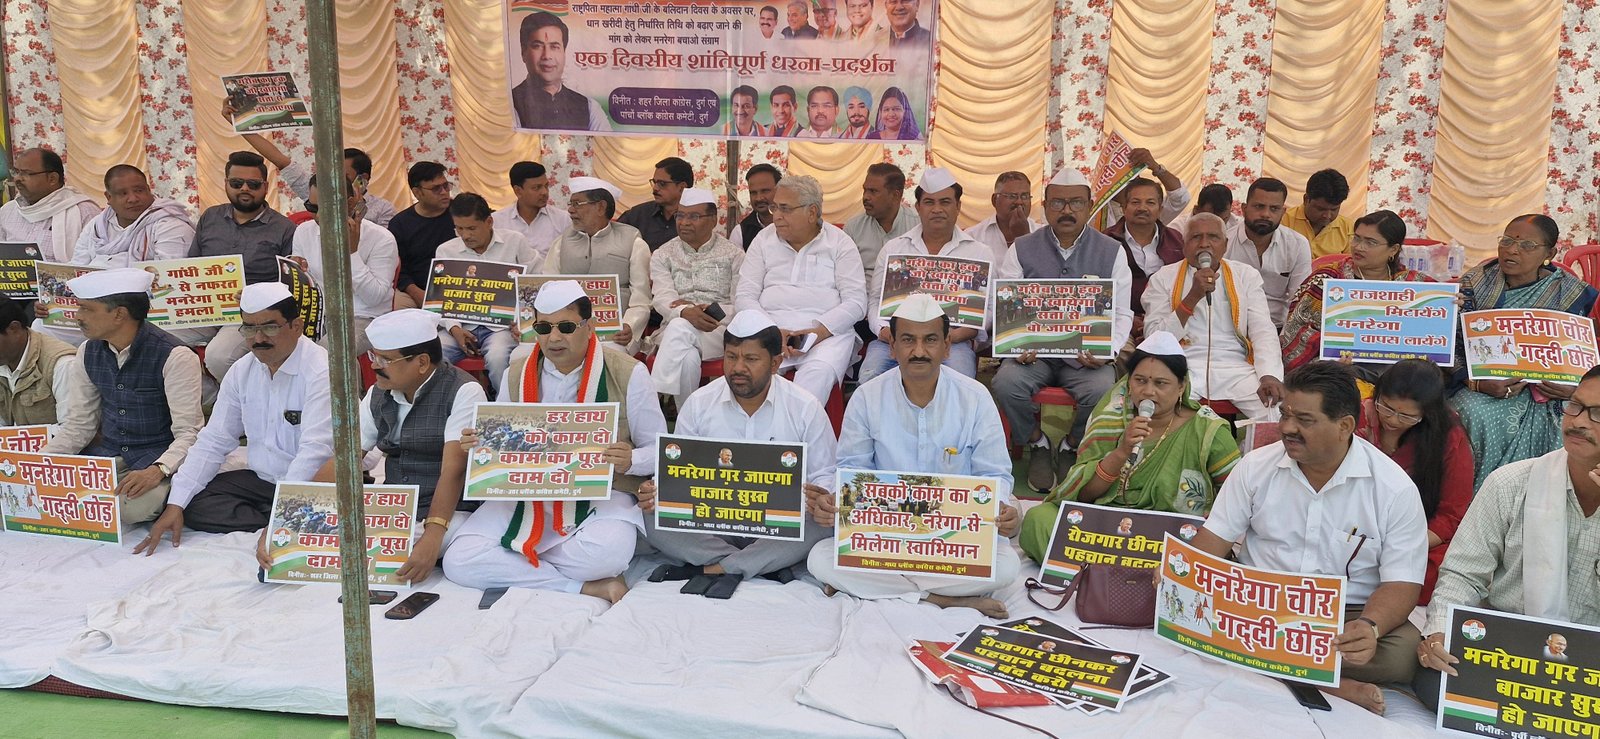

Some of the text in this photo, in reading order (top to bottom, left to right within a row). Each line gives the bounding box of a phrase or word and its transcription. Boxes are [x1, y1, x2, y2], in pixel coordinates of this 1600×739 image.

[600, 4, 622, 14] महात्मा
[624, 3, 640, 13] गांधी
[642, 3, 652, 13] जी
[653, 3, 661, 13] के
[663, 4, 689, 14] बलिदान
[691, 4, 709, 15] दिवस
[711, 4, 718, 14] के
[721, 7, 742, 15] अवसर
[744, 7, 756, 17] पर,
[586, 20, 600, 28] धान
[602, 17, 622, 28] खरीदी
[625, 18, 636, 31] हेतु
[637, 18, 665, 29] निर्धारित
[667, 19, 684, 29] तिथि
[685, 19, 695, 29] को
[716, 19, 730, 30] जाने
[732, 20, 742, 30] की
[623, 33, 632, 43] को
[634, 33, 652, 44] लेकर
[654, 33, 675, 44] मनरेगा
[677, 34, 699, 44] बचाओ
[701, 34, 719, 45] संग्राम
[575, 48, 897, 75] एक दिवसीय शांतिपूर्ण धरना-प्रदर्शन
[638, 97, 652, 106] शहर
[654, 95, 671, 106] जिला
[696, 97, 706, 109] दुर्ग
[707, 97, 717, 108] एवं
[637, 110, 654, 120] ब्लॉक
[656, 110, 675, 120] कांग्रेस
[699, 112, 709, 124] दुर्ग
[905, 257, 957, 269] गरीब का
[166, 264, 224, 279] गांधी जी
[910, 270, 928, 279] जो
[178, 279, 239, 292] से नफरत
[433, 274, 464, 286] मनरेगा
[480, 279, 515, 291] जाएगा
[586, 280, 611, 290] हाथ
[920, 281, 960, 292] सत्ता से
[1016, 283, 1076, 295] गरीब का
[165, 292, 235, 306] मनरेगा पर
[443, 288, 496, 303] बाजार सुस्त
[602, 293, 616, 304] दो
[1023, 297, 1096, 307] जो खायेगा
[1348, 288, 1416, 302] राजशाही
[174, 306, 215, 317] हमला
[443, 300, 490, 314] हो जाएगा
[1036, 309, 1081, 320] सत्ता से
[1385, 305, 1448, 319] मिटायेंगे
[594, 309, 617, 322] पूरा
[1026, 320, 1093, 333] वो जाएगा
[1336, 318, 1401, 331] मनरेगा
[1495, 312, 1591, 343] मनरेगा चोर
[1360, 334, 1448, 347] वापस लायेंगे
[1519, 342, 1562, 368] गद्दी
[547, 410, 608, 423] हर हाथ
[525, 428, 612, 443] को काम दो
[500, 452, 545, 464] काम
[546, 452, 574, 464] का
[19, 457, 110, 490] मनरेगा चोर
[508, 468, 571, 484] दाम दो
[667, 463, 716, 480] मनरेगा
[744, 470, 793, 486] जाएगा
[376, 492, 408, 506] हाथ
[690, 486, 769, 507] बाजार सुस्त
[864, 480, 970, 504] सबको काम का
[40, 494, 113, 527] गद्दी छोड़
[695, 503, 763, 523] हो जाएगा
[394, 512, 411, 528] दो
[852, 507, 982, 532] अधिकार, नरेगा से
[298, 533, 408, 554] काम पूरा
[1068, 526, 1126, 549] रोजगार
[851, 532, 980, 559] मिलेगा स्वाभिमान
[1195, 564, 1336, 617] मनरेगा चोर
[1217, 612, 1333, 663] गद्दी छोड़
[979, 635, 1119, 675] रोजगार छीनकर
[1463, 646, 1540, 676] मनरेगा
[974, 646, 1111, 685] पहचान बदलना
[997, 662, 1071, 689] बंद करो
[1495, 678, 1566, 707] बाजार
[1501, 702, 1527, 726] हो
